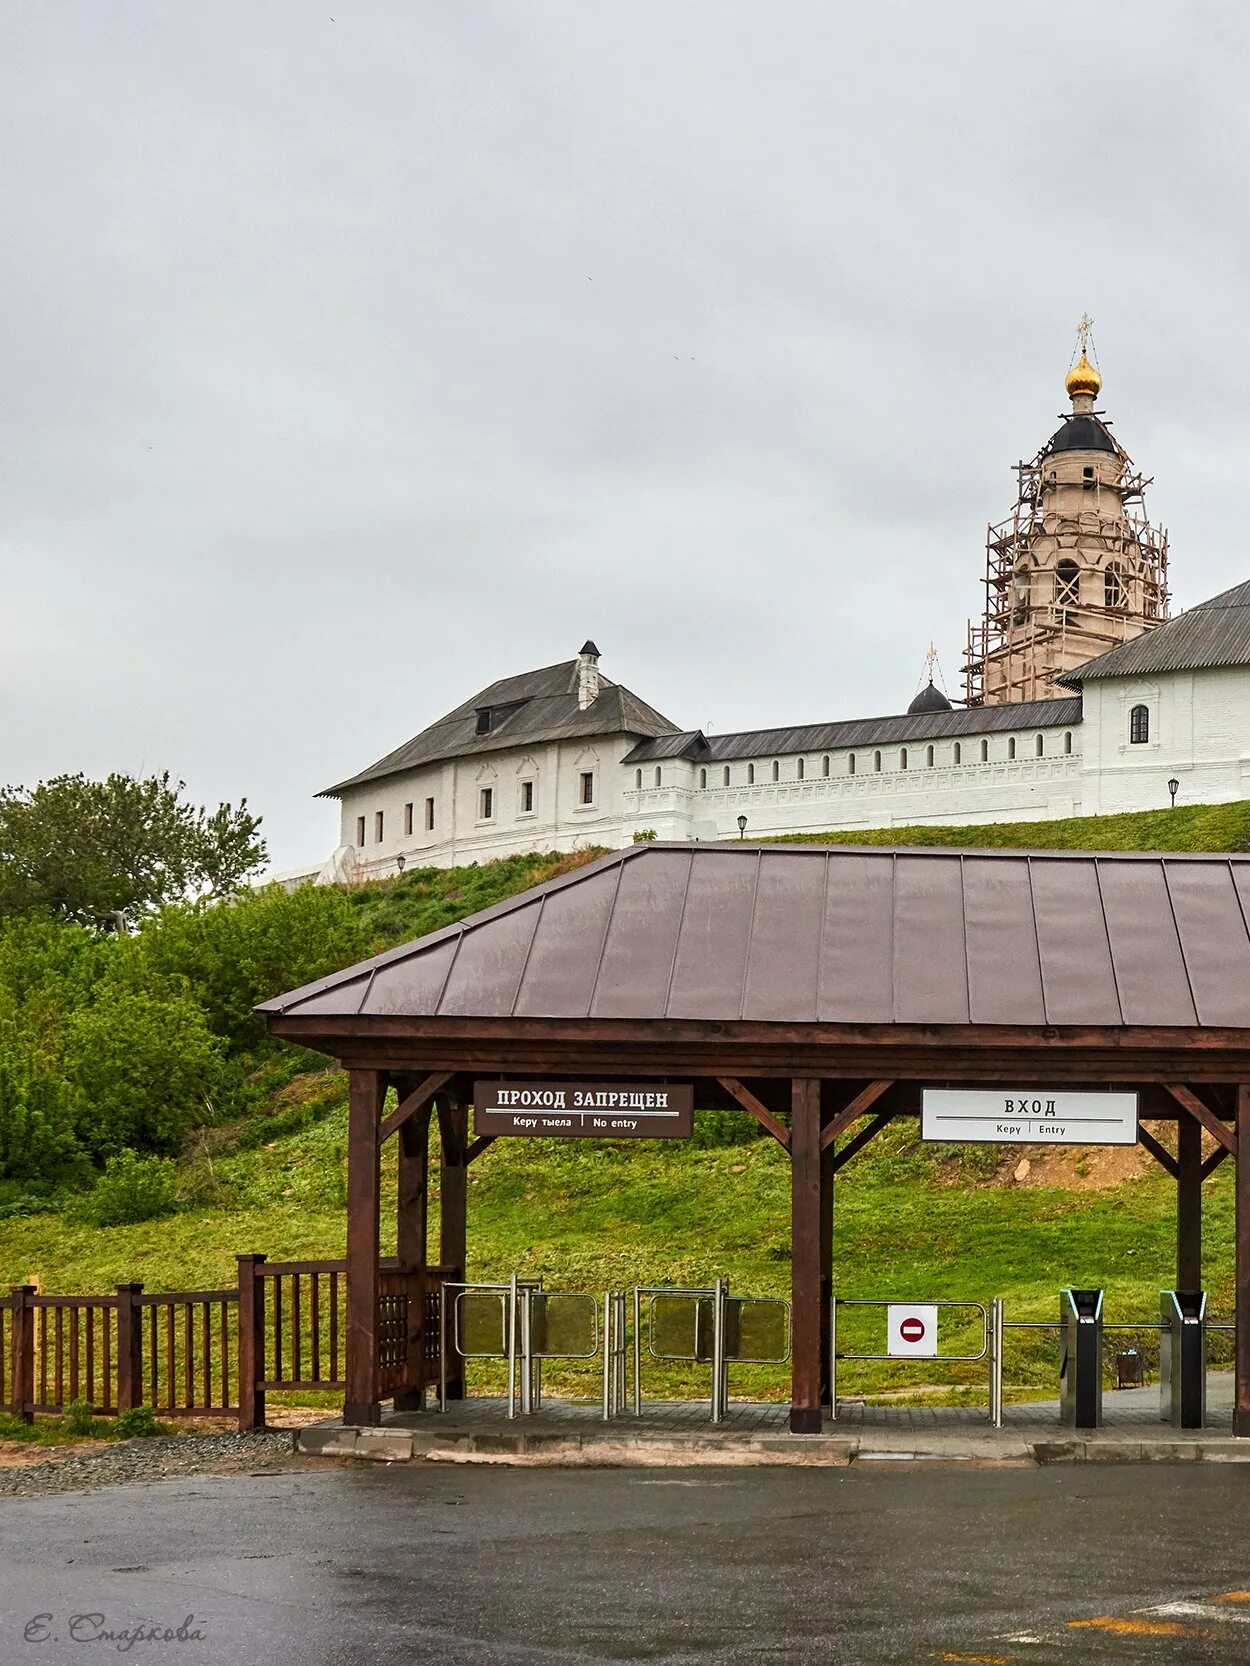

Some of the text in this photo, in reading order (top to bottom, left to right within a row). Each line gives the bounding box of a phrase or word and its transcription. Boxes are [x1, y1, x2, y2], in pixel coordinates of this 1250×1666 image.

[497, 1090, 668, 1110] ПРОХОД ЗАПРЕЩЕН
[1004, 1099, 1056, 1116] ВХОД
[542, 1118, 571, 1127] тыела
[593, 1118, 637, 1130] No entry
[1039, 1125, 1065, 1135] Entry
